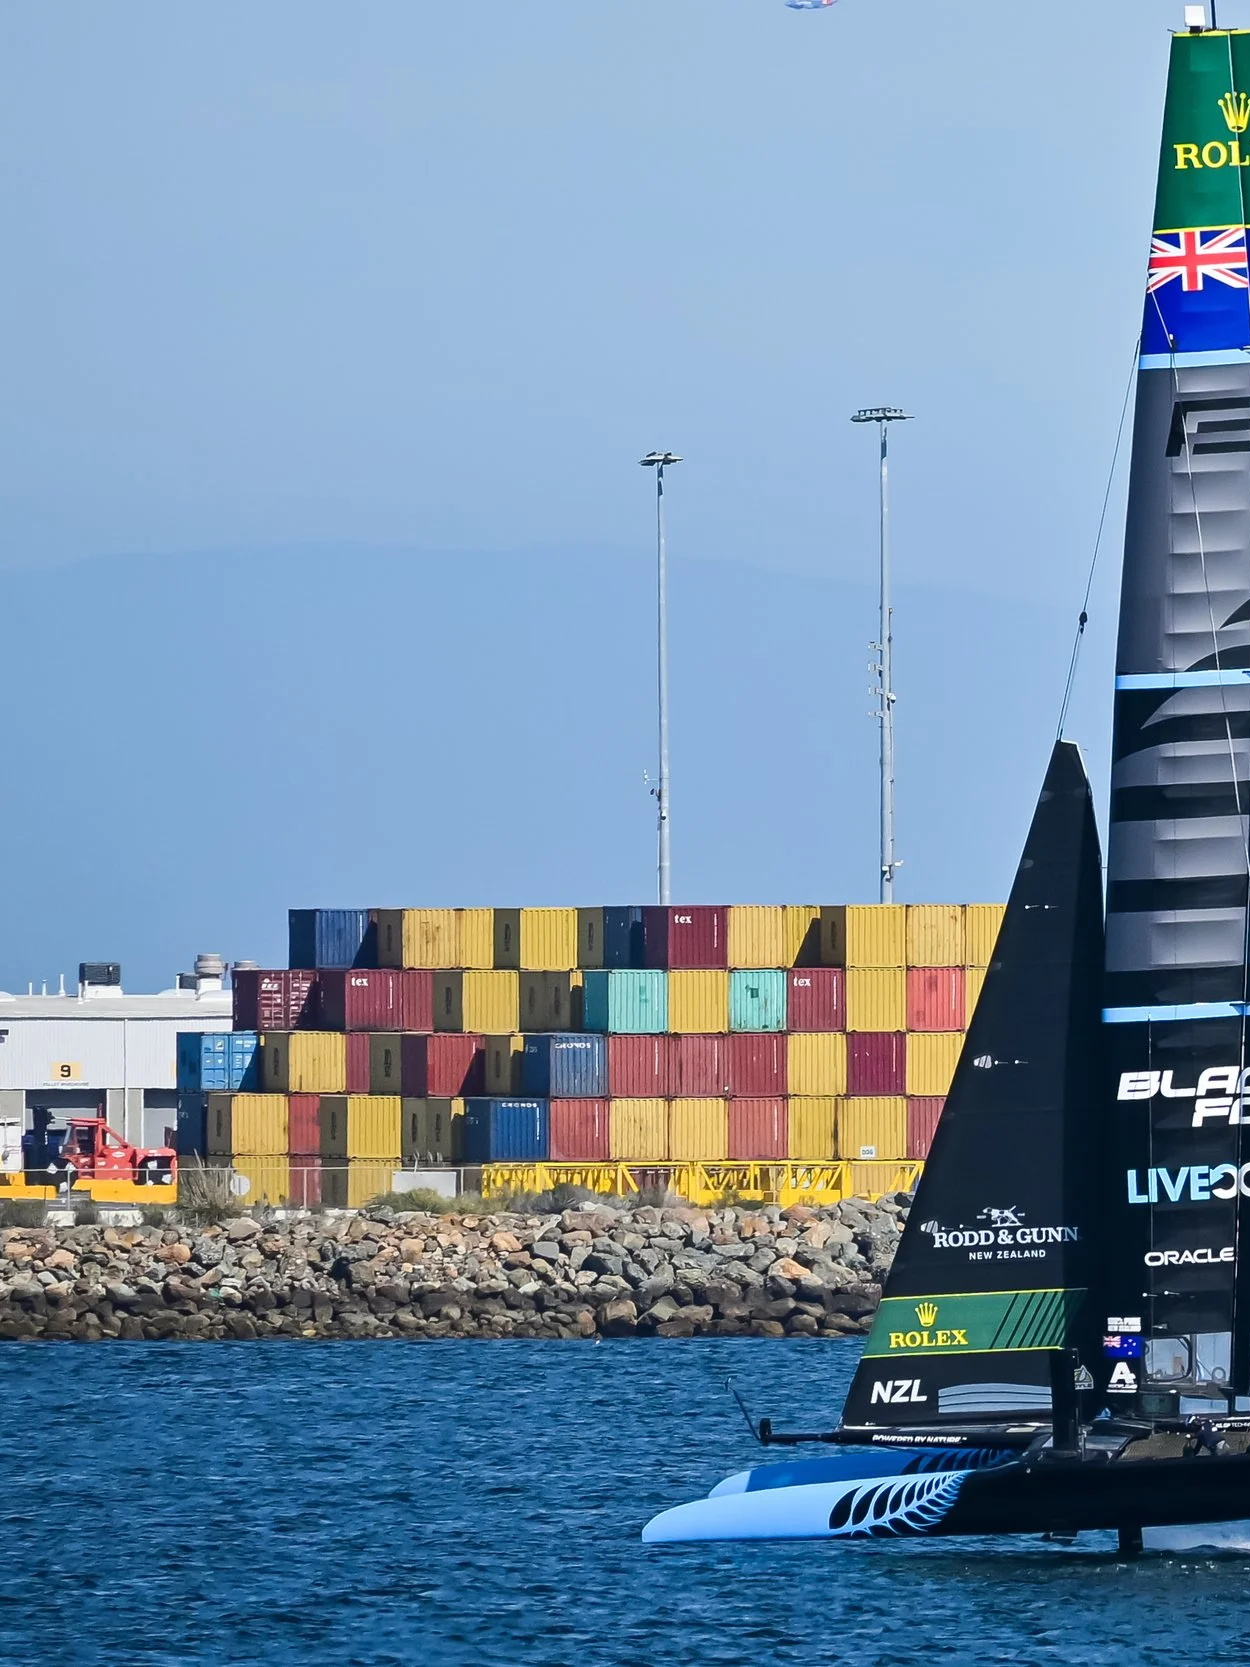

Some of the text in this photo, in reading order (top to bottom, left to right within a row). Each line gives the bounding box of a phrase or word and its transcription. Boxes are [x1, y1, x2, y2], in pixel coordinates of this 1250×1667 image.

[674, 914, 692, 924] tex
[351, 977, 369, 987] tex
[793, 976, 811, 987] tex
[60, 1064, 71, 1078] 9
[933, 1226, 1079, 1248] RODD & GUNN
[968, 1249, 1046, 1260] NEW ZEALAND
[1144, 1246, 1235, 1266] ORACLE
[888, 1329, 968, 1348] ROLEX
[870, 1378, 928, 1404] NZL
